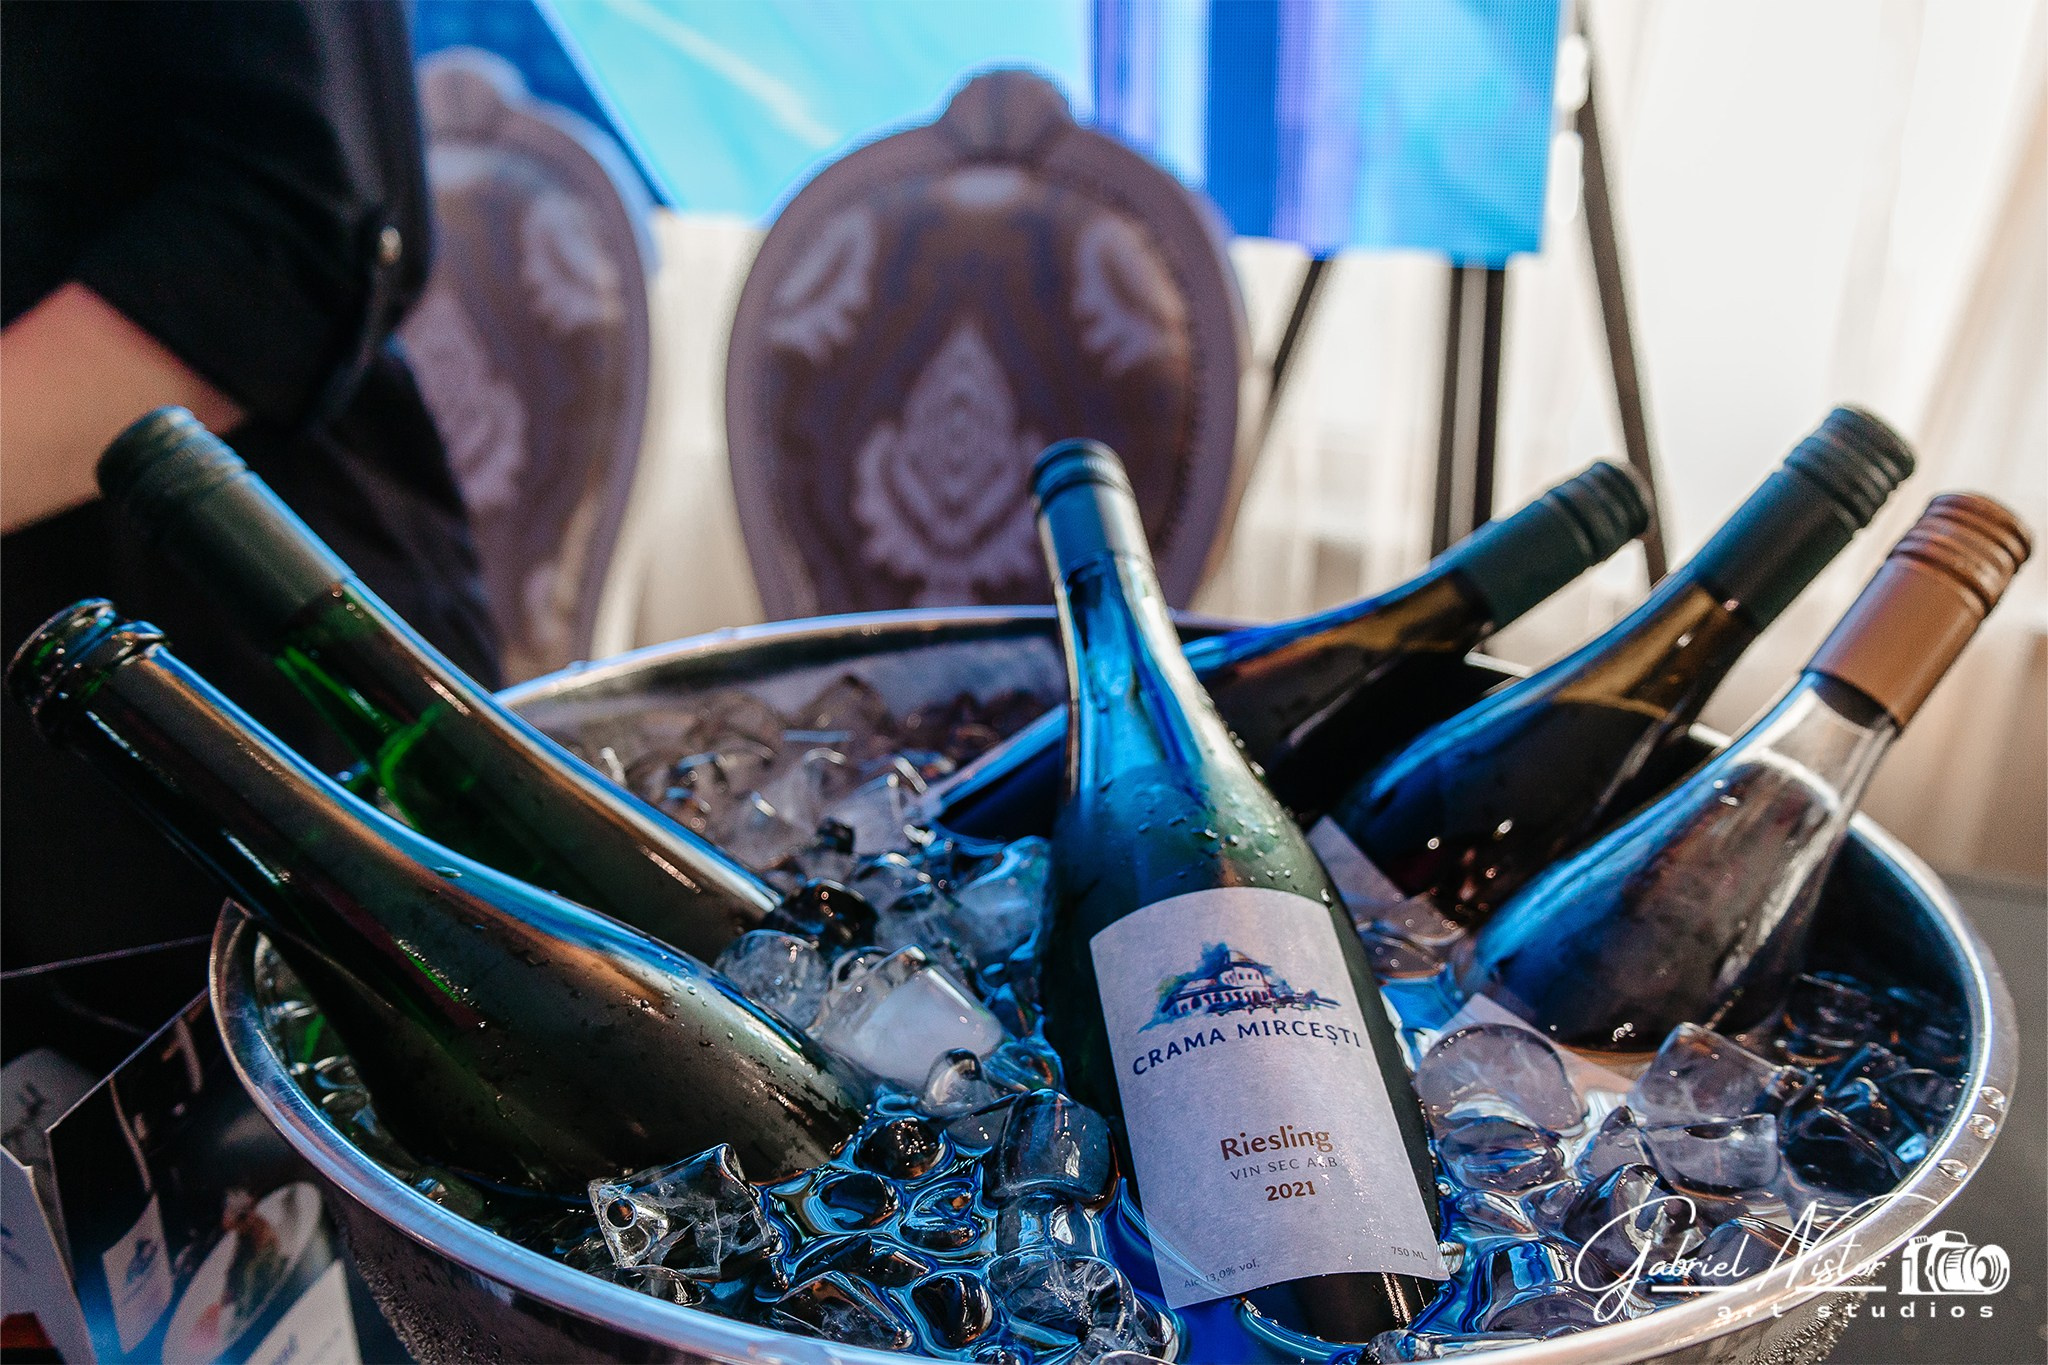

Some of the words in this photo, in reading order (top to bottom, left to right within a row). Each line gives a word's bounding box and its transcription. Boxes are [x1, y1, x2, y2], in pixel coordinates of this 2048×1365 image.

[1132, 1028, 1226, 1076] CRAMA
[1237, 1019, 1361, 1048] MIRCEȘTI
[1220, 1124, 1333, 1161] Riesling
[1230, 1165, 1261, 1180] VIN
[1267, 1158, 1300, 1173] SEC
[1264, 1180, 1316, 1202] 2021
[1239, 1258, 1260, 1271] vol.
[1390, 1246, 1410, 1257] 750
[1412, 1250, 1428, 1261] ML
